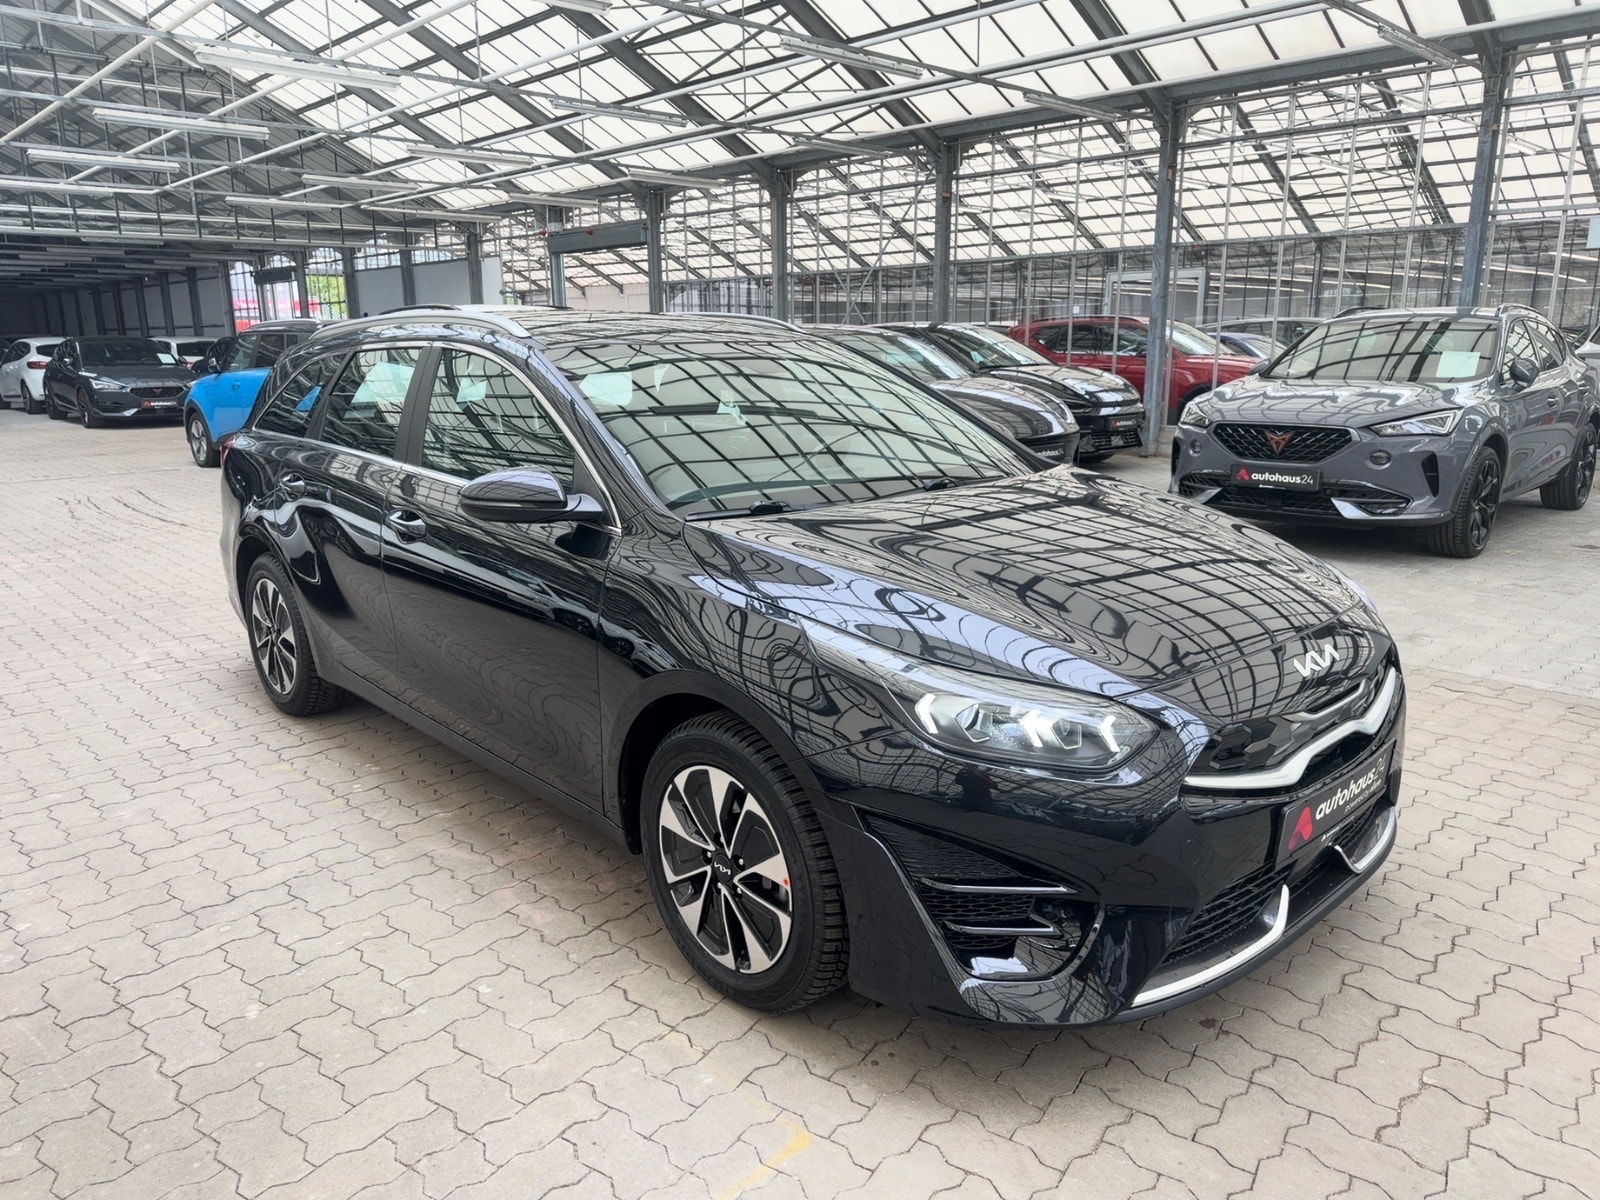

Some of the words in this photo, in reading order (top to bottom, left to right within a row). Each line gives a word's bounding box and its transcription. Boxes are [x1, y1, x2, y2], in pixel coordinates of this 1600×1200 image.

[1251, 472, 1313, 485] autohaus24
[1293, 643, 1340, 677] KIA
[1315, 754, 1387, 820] autohaus24
